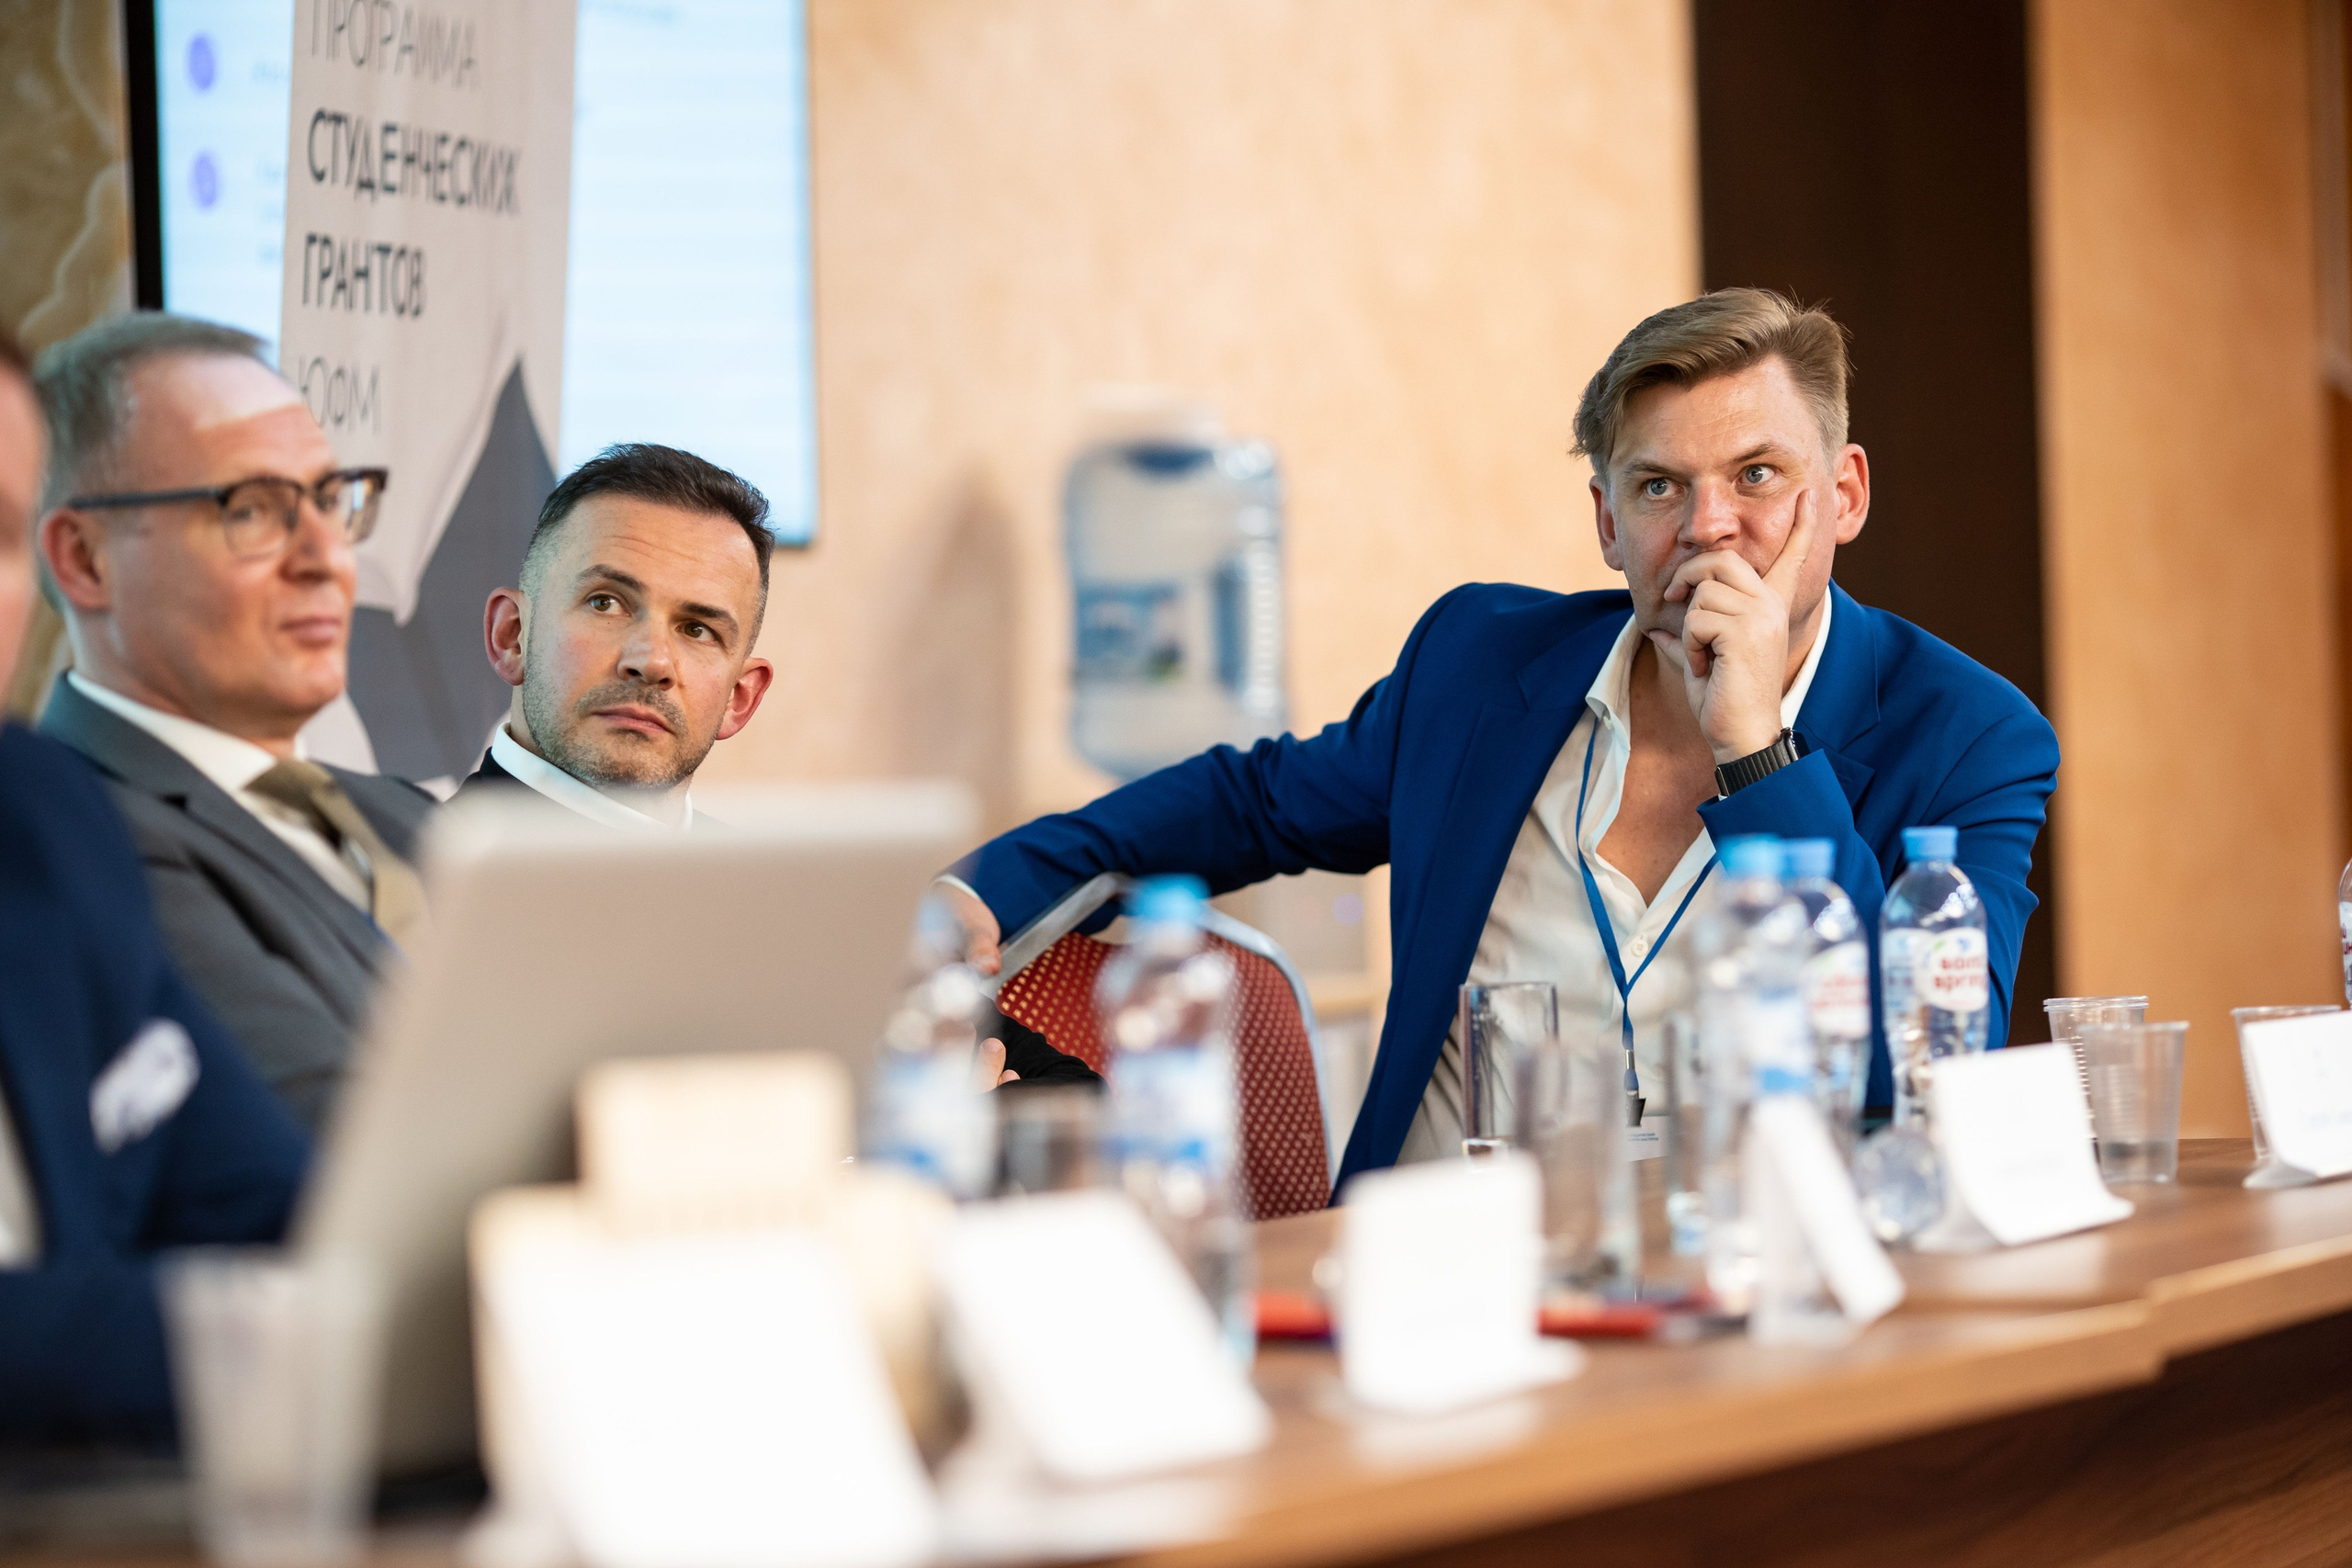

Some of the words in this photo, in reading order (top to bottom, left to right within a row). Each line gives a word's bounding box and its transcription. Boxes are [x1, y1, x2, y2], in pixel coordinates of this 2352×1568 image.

[311, 0, 480, 89] ПРОГРАММА
[308, 107, 521, 216] СТУДЕНЧЕСКИХ
[302, 231, 426, 319] ГРАНТОВ
